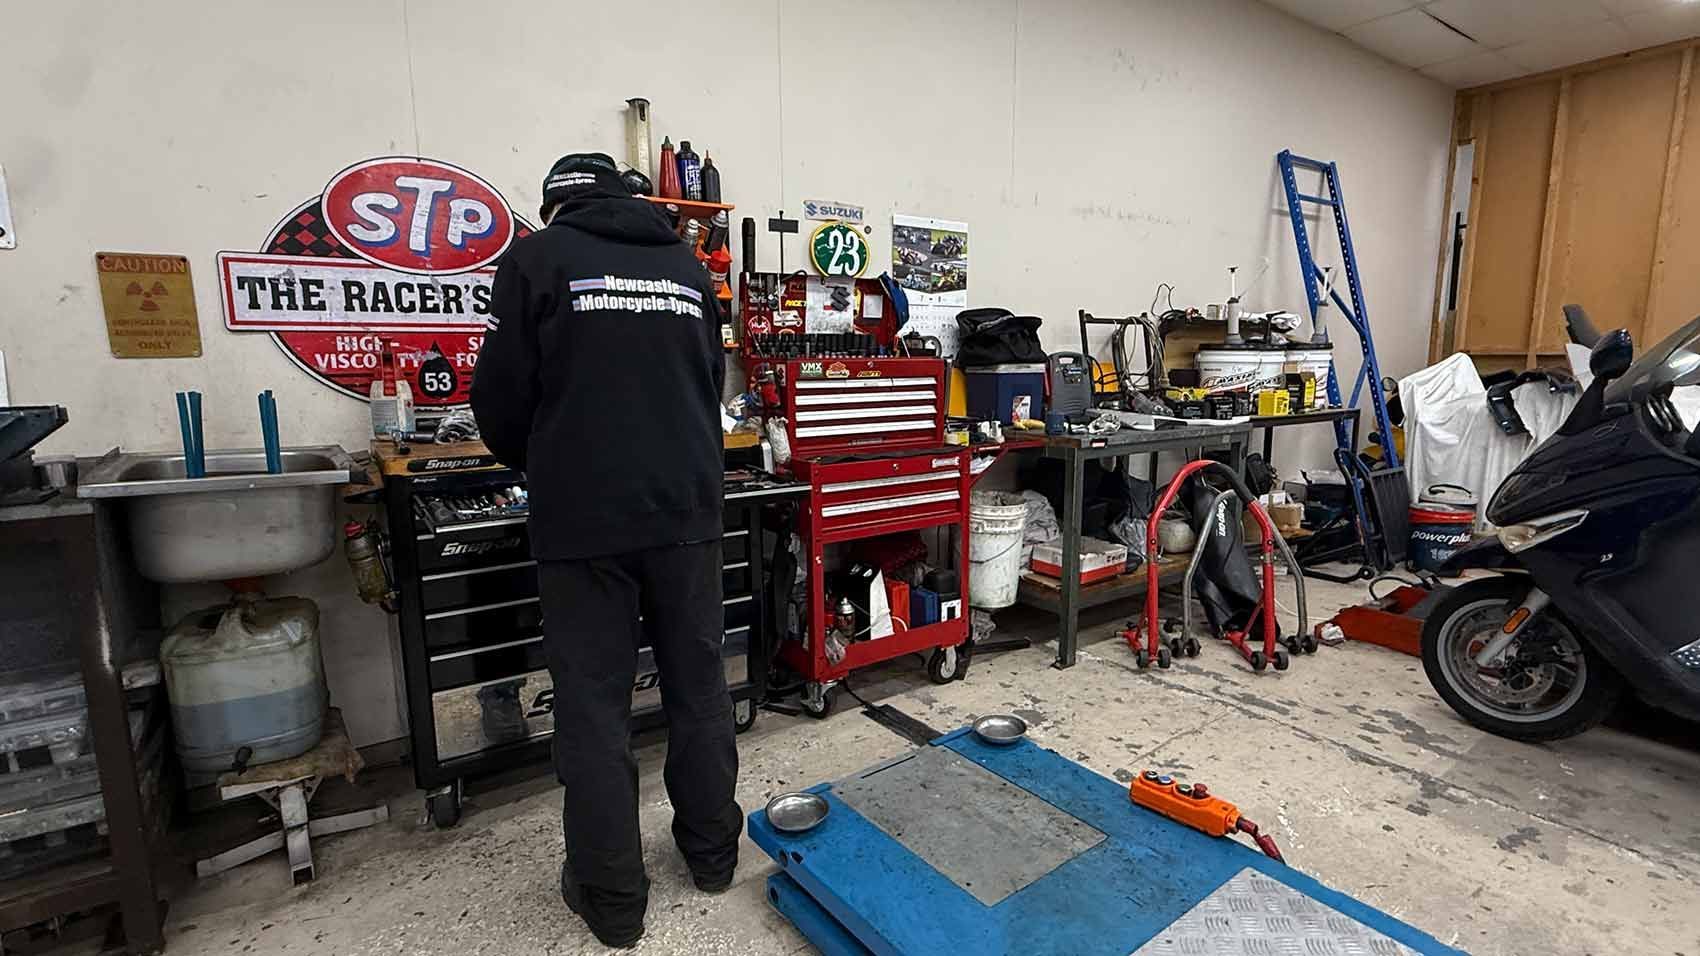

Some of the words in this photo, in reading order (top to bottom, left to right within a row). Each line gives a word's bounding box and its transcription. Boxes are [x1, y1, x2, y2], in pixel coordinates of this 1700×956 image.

[346, 176, 493, 252] STP
[820, 206, 863, 220] SUZUKI
[828, 229, 860, 276] 23
[102, 259, 185, 273] CAUTION
[604, 275, 680, 294] Newcastle
[237, 276, 326, 311] THE
[344, 281, 491, 314] RACER'S
[579, 293, 667, 313] Motorcycle
[669, 296, 702, 319] Tyres
[314, 353, 420, 369] VISCOTY
[801, 362, 822, 370] VMX
[425, 373, 452, 392] 53
[425, 458, 481, 470] Snap-on
